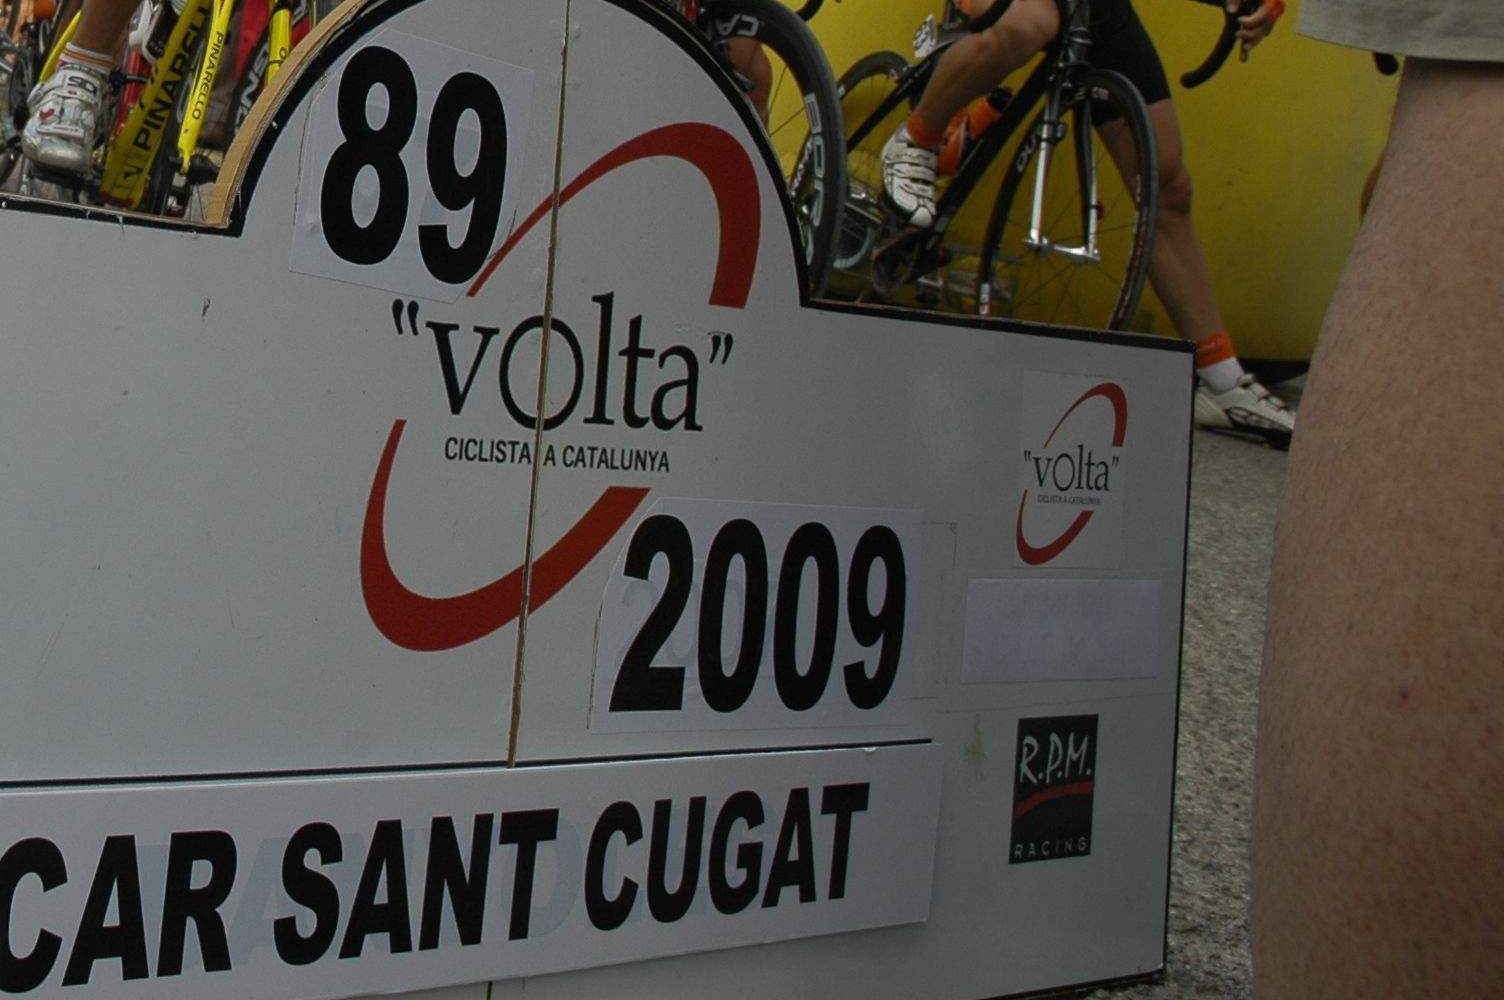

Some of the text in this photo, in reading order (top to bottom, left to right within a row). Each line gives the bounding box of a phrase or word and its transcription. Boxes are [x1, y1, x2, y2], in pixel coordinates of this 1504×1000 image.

[191, 31, 226, 121] PINARELLO
[320, 46, 508, 285] 89
[444, 436, 670, 473] CICLISTA A CATALUNYA
[608, 514, 907, 716] 2009
[272, 807, 559, 967] SANT
[583, 781, 871, 933] CUGAT
[1014, 836, 1088, 859] RACING
